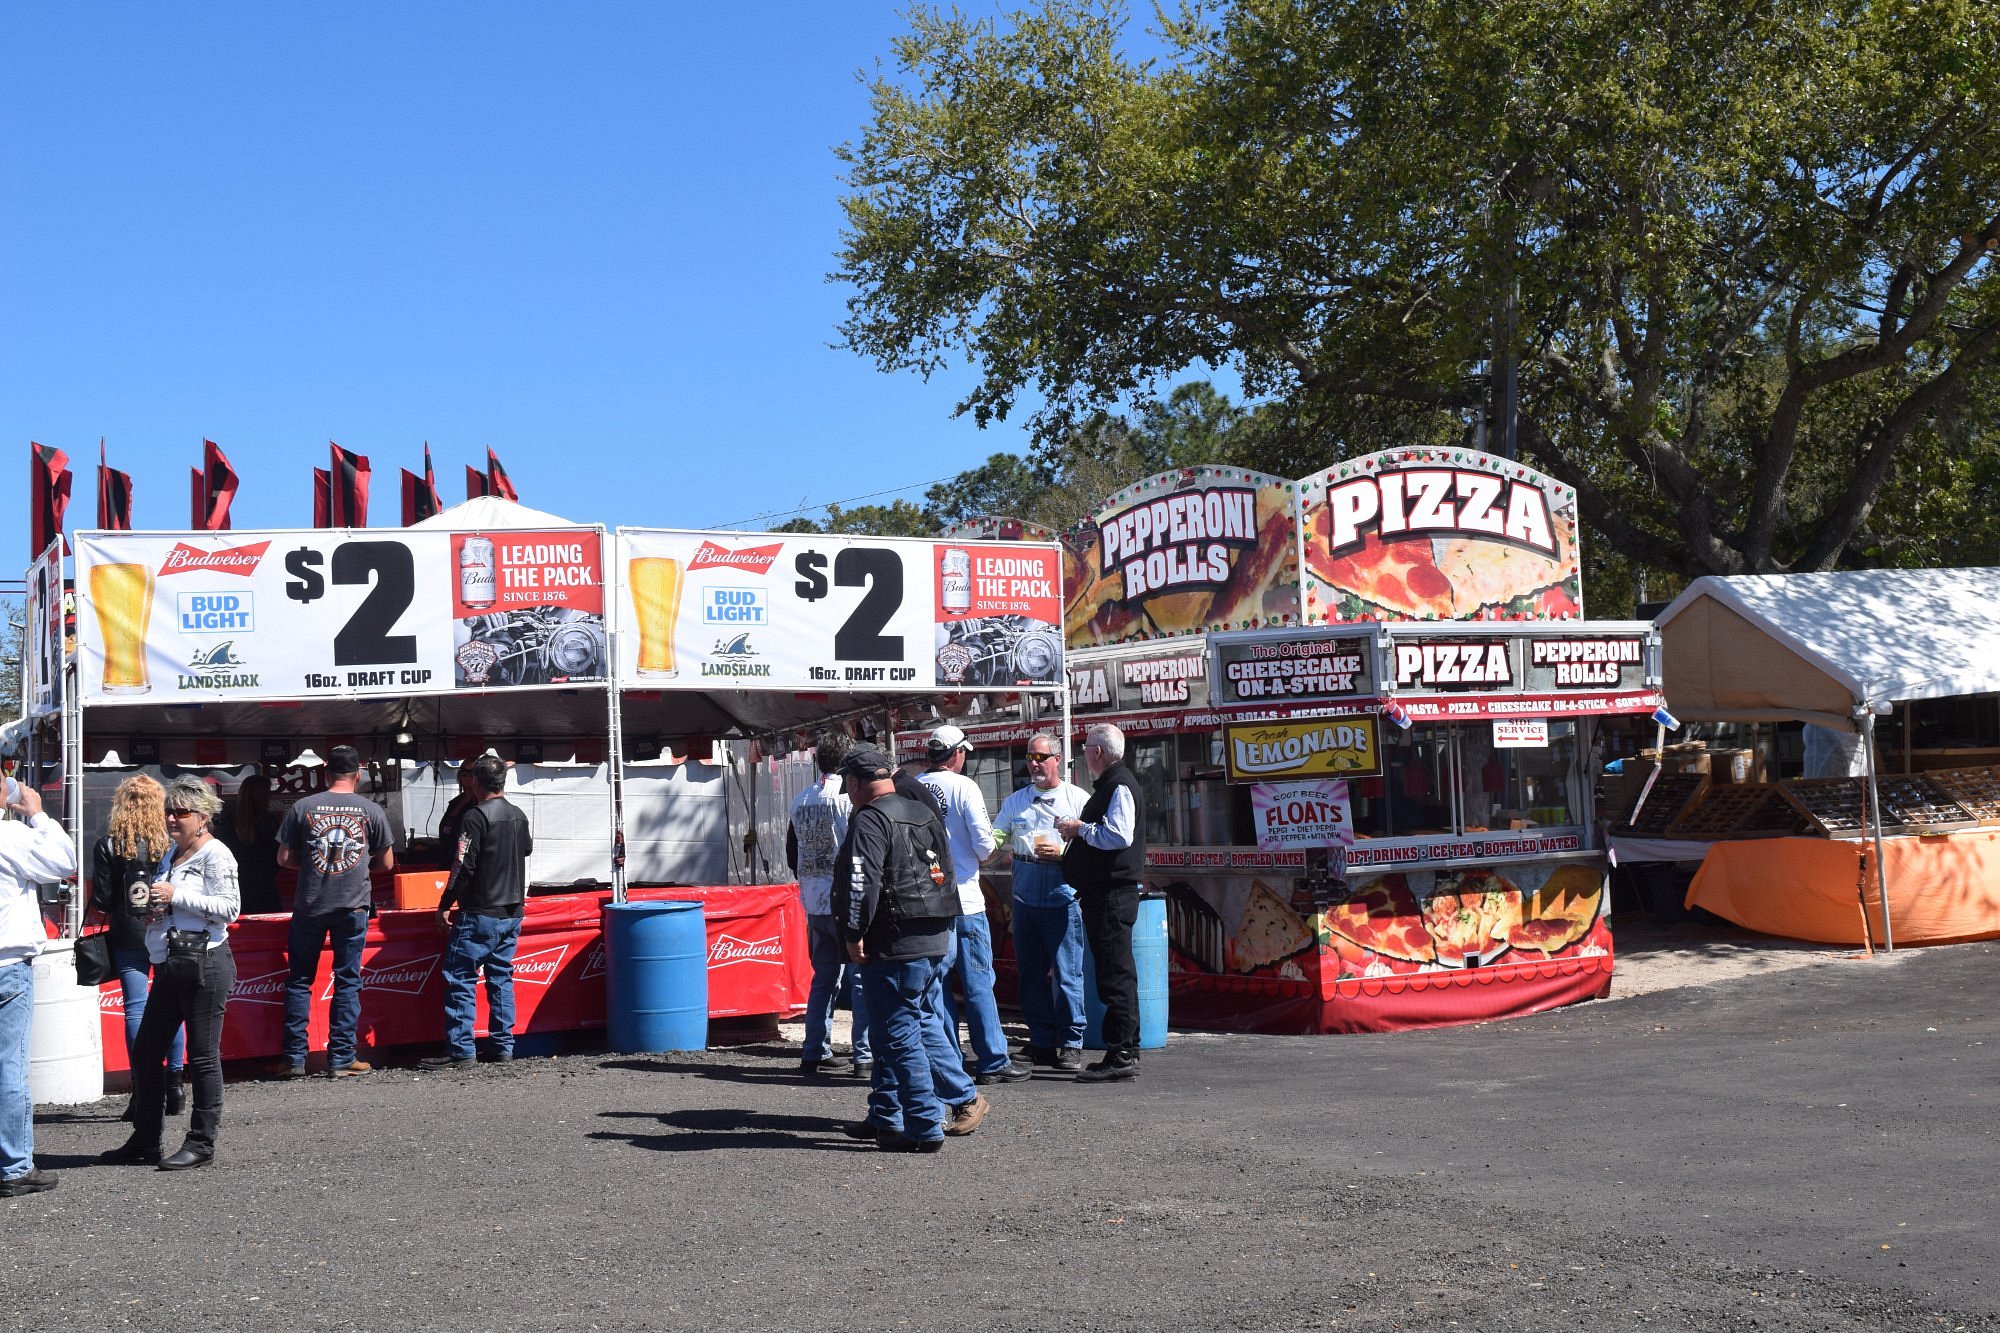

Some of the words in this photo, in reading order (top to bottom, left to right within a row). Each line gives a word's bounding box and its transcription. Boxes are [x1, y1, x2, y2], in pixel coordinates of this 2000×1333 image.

[1330, 470, 1555, 550] PIZZA
[1102, 492, 1255, 568] PEPPERONI
[165, 550, 262, 568] Budweiser
[502, 544, 582, 565] LEADING
[694, 547, 776, 564] Budweiser
[502, 567, 538, 588] THE
[544, 566, 596, 587] PACK.
[976, 558, 1043, 578] LEADING
[1125, 544, 1229, 600] ROLLS
[503, 592, 540, 602] SINCE
[543, 591, 568, 601] 1876.
[976, 578, 1007, 597] THE
[1011, 579, 1055, 598] PACK.
[191, 596, 240, 613] BUD
[285, 541, 417, 666] $2
[714, 591, 756, 606] BUD
[795, 547, 904, 661] $2
[976, 601, 1008, 610] SINCE
[1010, 601, 1031, 611] 1876.
[182, 612, 249, 629] LIGHT
[706, 606, 763, 622] LIGHT
[1251, 645, 1276, 658] The
[1280, 640, 1336, 658] Original
[1533, 641, 1641, 663] PEPPERONI
[701, 662, 771, 677] LANDSHARK
[808, 667, 841, 680] 16oz.
[845, 667, 886, 681] DRAFT
[889, 667, 916, 681] CUP
[1123, 656, 1203, 684] PEPPERONI
[1228, 655, 1361, 680] CHEESECAKE
[1396, 645, 1510, 683] PIZZA
[1557, 662, 1618, 684] ROLLS
[178, 674, 260, 690] LANDSHARK
[304, 673, 342, 689] 16oz.
[347, 671, 395, 687] DRAFT
[400, 669, 432, 685] CUP
[1238, 674, 1353, 697] ON-A-STICK
[1141, 680, 1188, 703] ROLLS
[1405, 703, 1440, 715] PASTA
[1448, 702, 1479, 714] PIZZA
[1487, 700, 1551, 713] CHEESECAKE
[1553, 699, 1607, 711] ON-A-STICK
[1615, 697, 1641, 708] SOFT
[1116, 720, 1150, 731] BOTTLED
[1151, 718, 1176, 729] WATER
[1184, 713, 1233, 727] PEPPERONI
[1237, 709, 1278, 721] ROLLS
[1290, 706, 1361, 718] MEATBALL
[1252, 727, 1288, 742] Fresh
[1497, 726, 1544, 734] SERVICE
[1233, 726, 1367, 774] LEMONADE
[1273, 791, 1297, 801] ROOT
[1300, 790, 1329, 800] BEER
[1266, 800, 1342, 827] FLOATS
[1268, 827, 1288, 835] PEPSI
[1297, 825, 1313, 833] DIET
[1315, 824, 1336, 832] PEPSI
[1281, 833, 1307, 842] PEPPER
[1327, 831, 1342, 839] DEW
[1154, 852, 1185, 866] DRINKS
[1191, 852, 1207, 866] ICE
[1207, 852, 1224, 866] TEA
[1231, 852, 1272, 866] BOTTLED
[1346, 851, 1370, 864] OFT
[1374, 846, 1418, 863] DRINKS
[1428, 844, 1449, 859] ICE
[1450, 842, 1475, 857] TEA
[1485, 838, 1537, 855] BOTTLED
[1539, 835, 1578, 850] WATER
[710, 941, 782, 961] Budweis
[361, 969, 429, 985] udweiser
